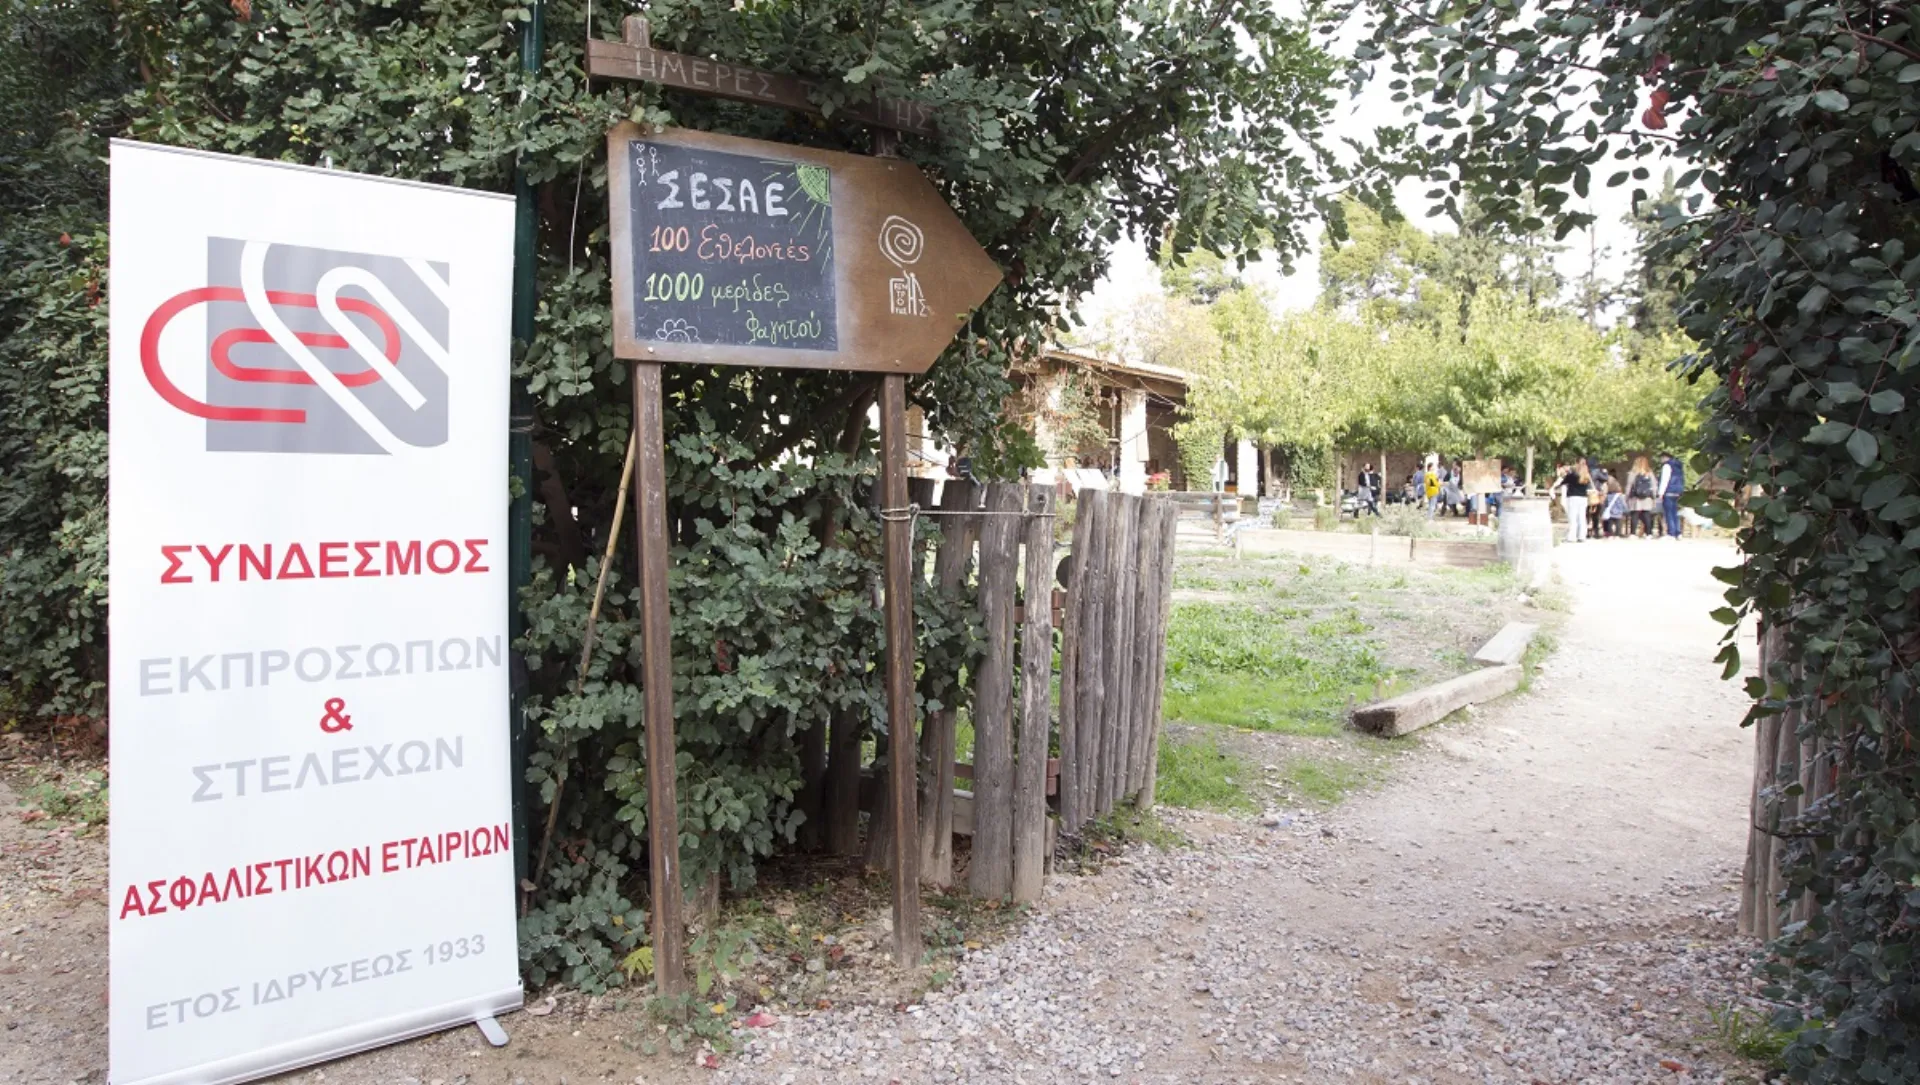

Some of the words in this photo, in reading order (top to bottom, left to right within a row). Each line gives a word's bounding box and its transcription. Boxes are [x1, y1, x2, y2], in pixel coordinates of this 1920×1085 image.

[636, 50, 776, 98] ΗΜΕΡΕΣ
[657, 169, 789, 217] ΣΕΣΑΕ
[649, 225, 690, 252] 100
[644, 271, 705, 302] 1000
[711, 273, 790, 313] μερίδες
[160, 538, 490, 585] ΣΥΝΔΕΣΜΟΣ
[139, 634, 503, 697] ΕΚΠΡΟΣΩΠΩΝ
[319, 697, 354, 734] &
[191, 735, 465, 803] ΣΤΕΛΕΧΩΝ
[119, 846, 371, 920] ΑΣΦΑΛΙΣΤΙΚΩΝ
[381, 822, 510, 874] ΕΤΑΙΡΙΩΝ
[146, 986, 241, 1031] ΕΤΟΣ
[252, 949, 413, 1006] ΙΔΡΥΣΕΩΣ
[422, 933, 486, 967] 1933
